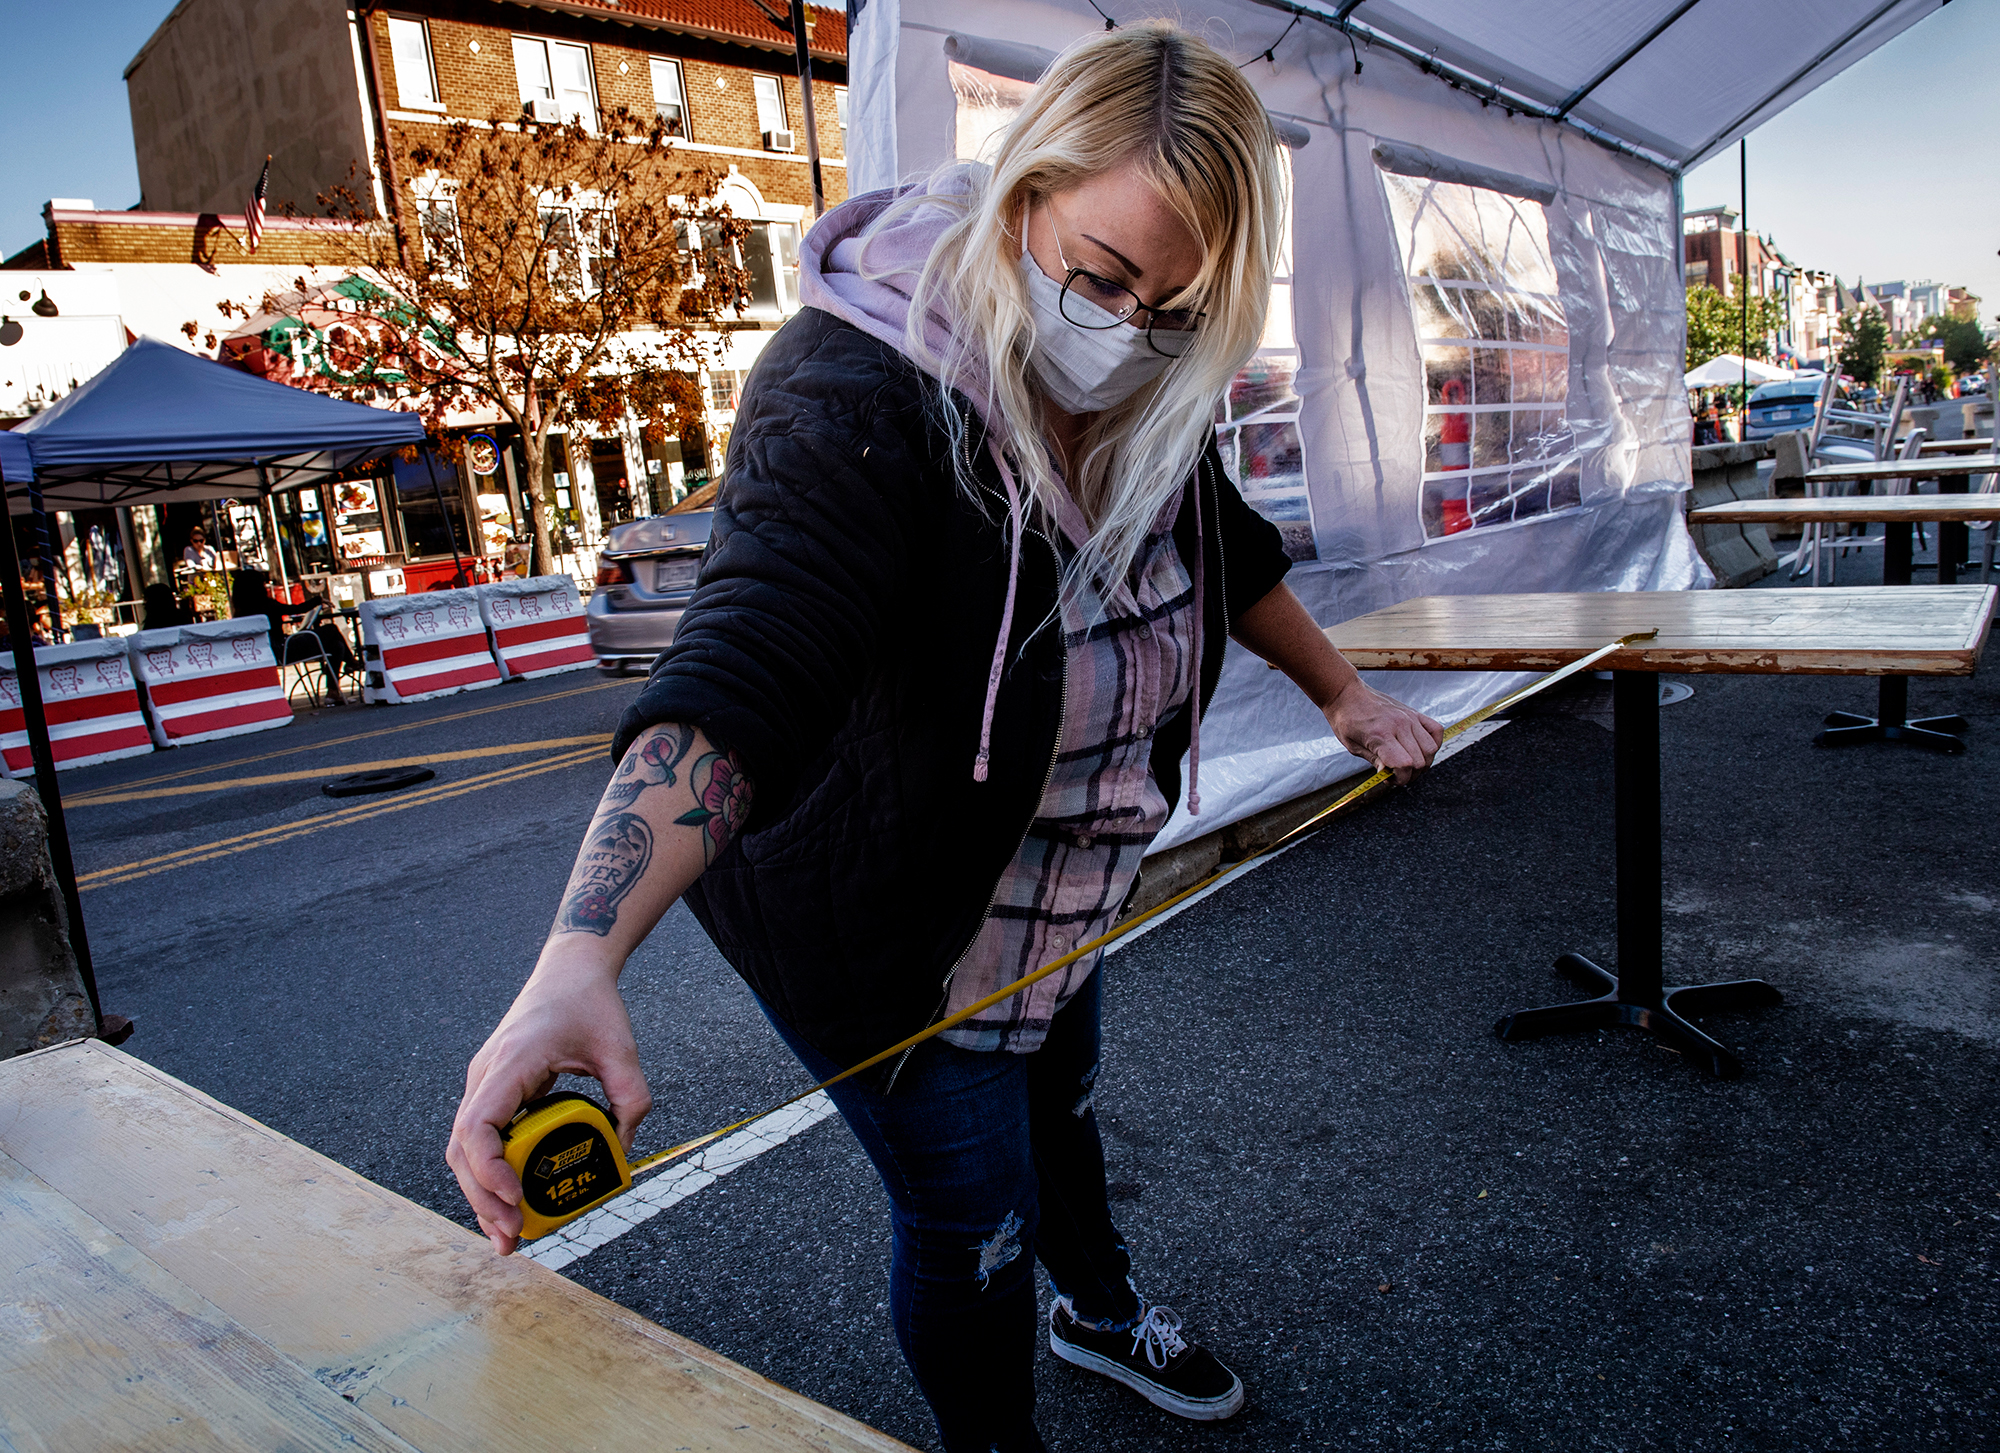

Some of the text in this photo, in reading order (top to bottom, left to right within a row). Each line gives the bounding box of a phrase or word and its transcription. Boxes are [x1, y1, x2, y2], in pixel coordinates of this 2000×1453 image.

[546, 1171, 596, 1200] 12 ft.
[579, 1187, 589, 1195] in.
